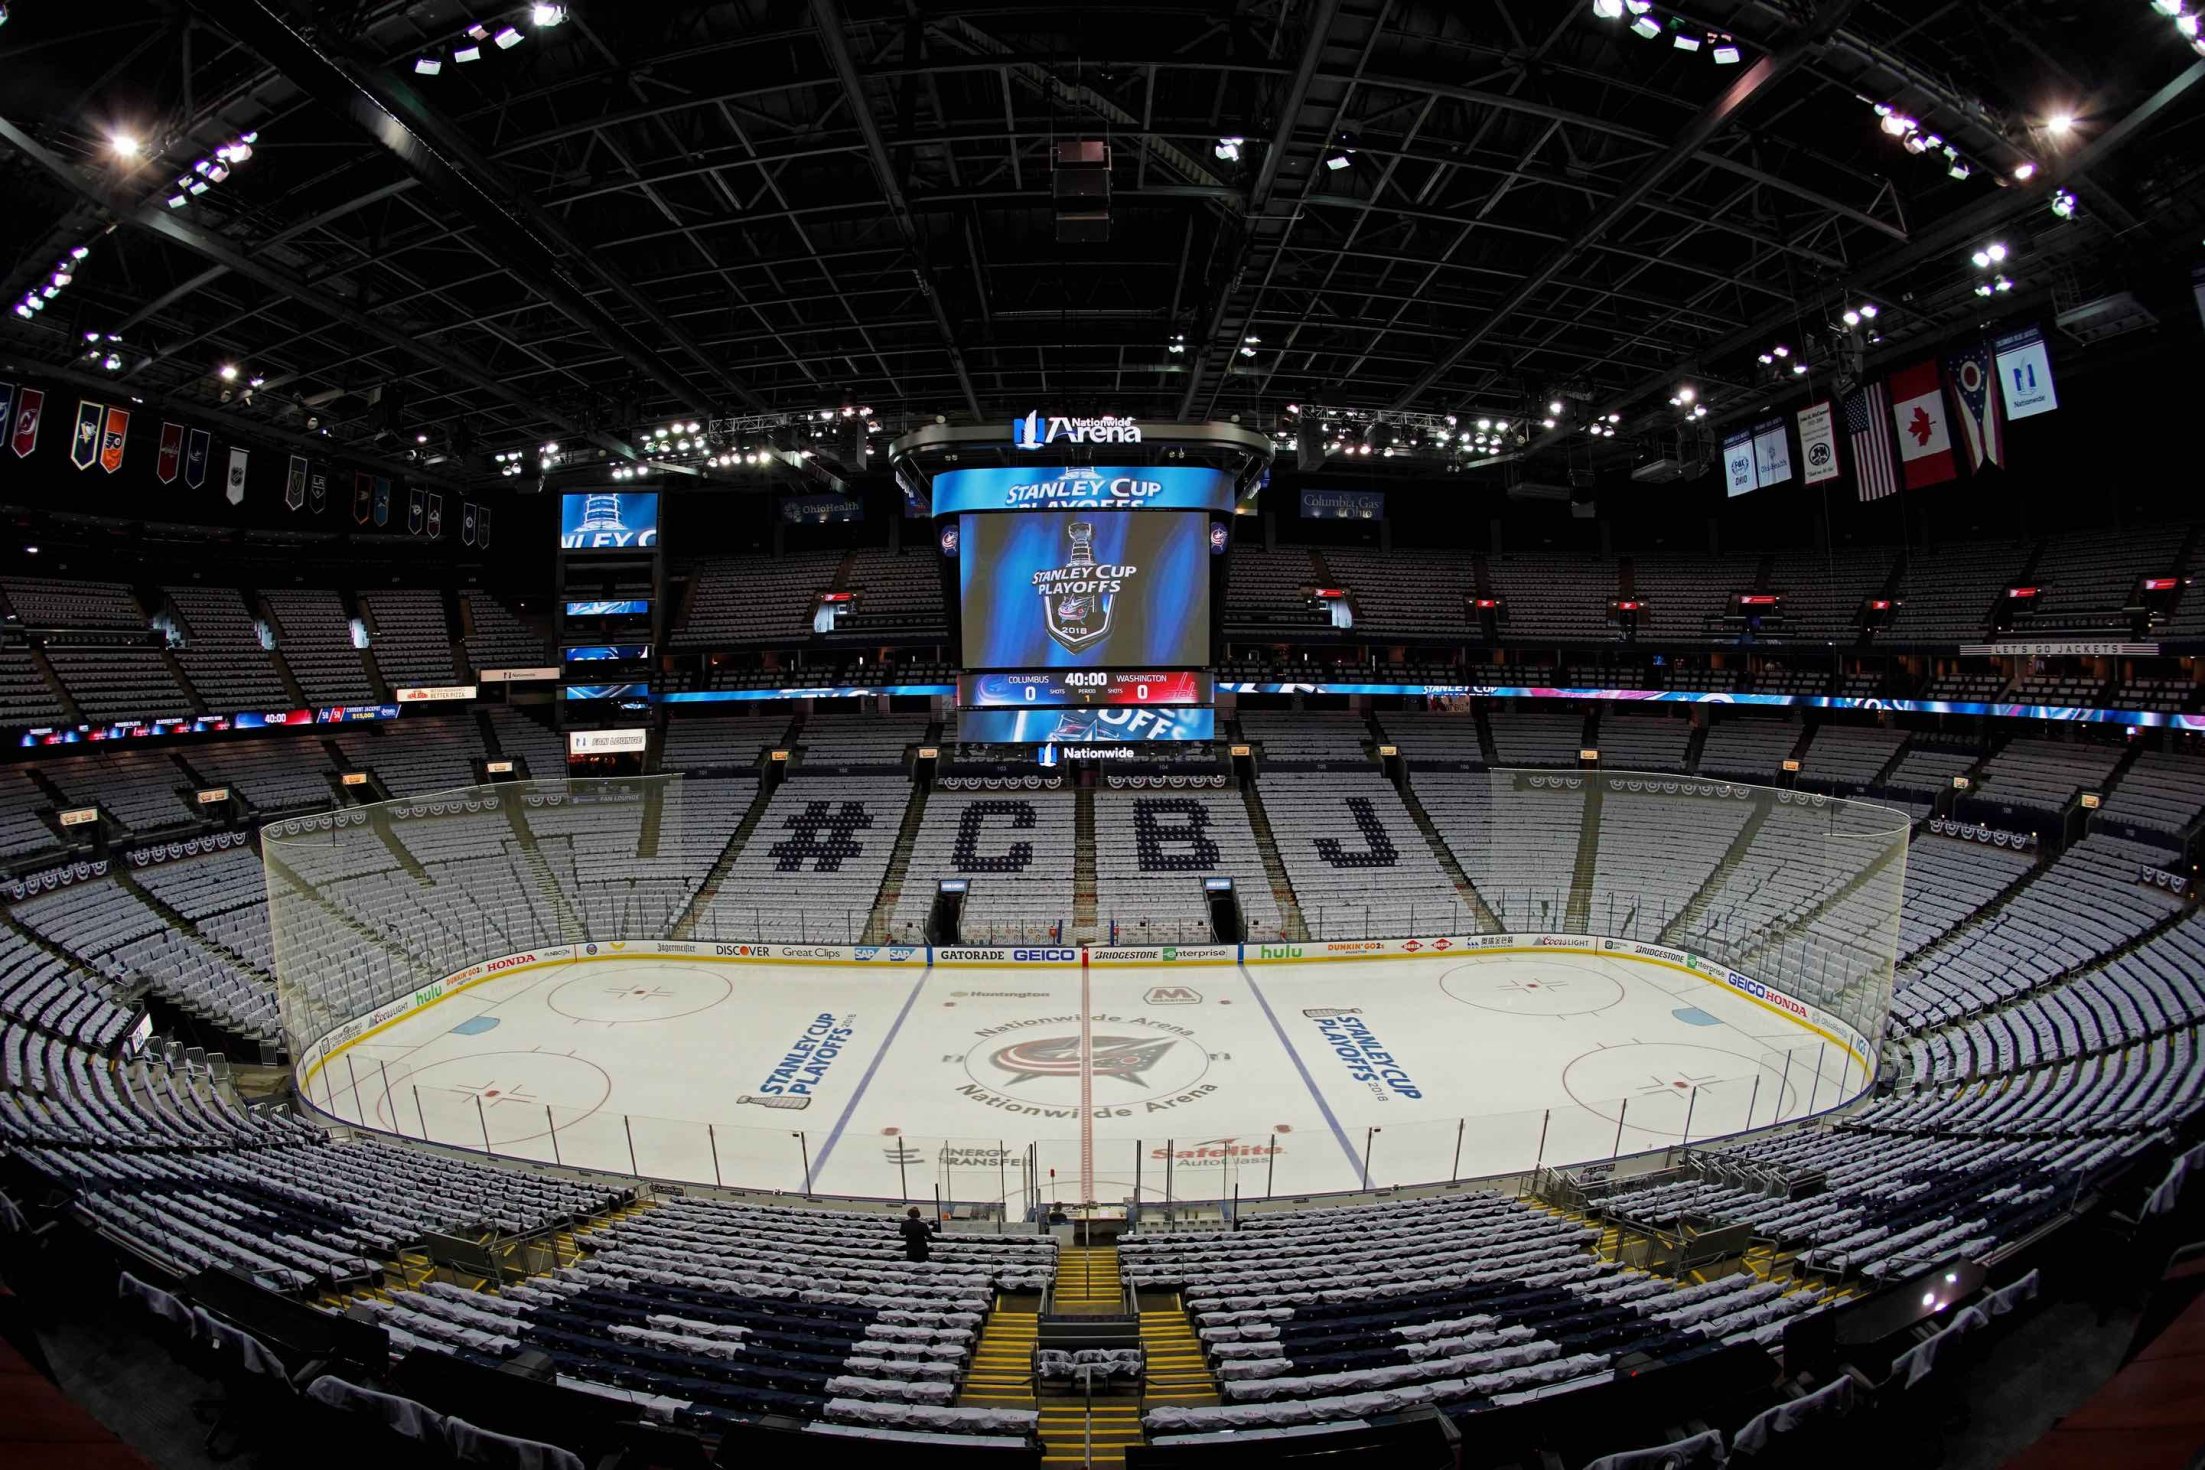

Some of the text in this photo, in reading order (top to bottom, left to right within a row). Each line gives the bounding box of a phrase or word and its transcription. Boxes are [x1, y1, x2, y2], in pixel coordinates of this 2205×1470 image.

[1045, 416, 1142, 443] Arena
[1072, 417, 1131, 427] Nationwide
[1006, 479, 1162, 504] STANLEY CUP
[802, 501, 860, 514] OhioHealth
[1304, 494, 1380, 509] Columbia Gas
[1031, 564, 1137, 585] STANLEY CUP
[1038, 580, 1121, 595] PLAYOFFS
[1061, 626, 1088, 635] 2018
[1995, 645, 2119, 653] LETS GO JACKETS
[1008, 672, 1168, 686] COLUMBUS 40:00 WASHINGTON
[1025, 686, 1036, 701] 0
[1137, 684, 1148, 700] 0
[265, 714, 287, 723] 40:00
[610, 736, 643, 746] LOUNGE
[1063, 747, 1135, 759] Nationwide
[1327, 943, 1364, 951] DUNKIN'
[1542, 935, 1589, 947] Coors LIGHT
[716, 945, 770, 957] DISCOVER
[782, 947, 841, 959] Great Clips
[854, 949, 875, 960] SAP
[890, 950, 909, 960] SAP
[940, 950, 1005, 961] GATORADE
[1013, 949, 1076, 962] GEICO
[1094, 950, 1159, 960] BRIDGESTONE
[1166, 948, 1226, 960] enterprise
[1260, 944, 1303, 959] hulu
[1634, 944, 1685, 963] BRIDGESTONE
[486, 954, 537, 973] HONDA
[1690, 958, 1726, 978] enterprise
[446, 970, 469, 986] DUNKIN'
[1728, 972, 1765, 999] GEICO
[415, 984, 443, 1006] hulu
[970, 990, 1050, 999] Huntington
[390, 1002, 409, 1018] LIGHT
[1765, 990, 1808, 1018] HONDA
[974, 1013, 1196, 1039] Nationwide Arena
[760, 1013, 837, 1095] STANLEY CUP
[1312, 1018, 1380, 1082] PLAYOFFS
[788, 1027, 853, 1095] PLAYOFFS
[1336, 1016, 1401, 1069] STANLEY
[1380, 1069, 1423, 1100] CUP
[954, 1082, 1219, 1119] Nationwide Arena
[1150, 1144, 1284, 1160] Safelite
